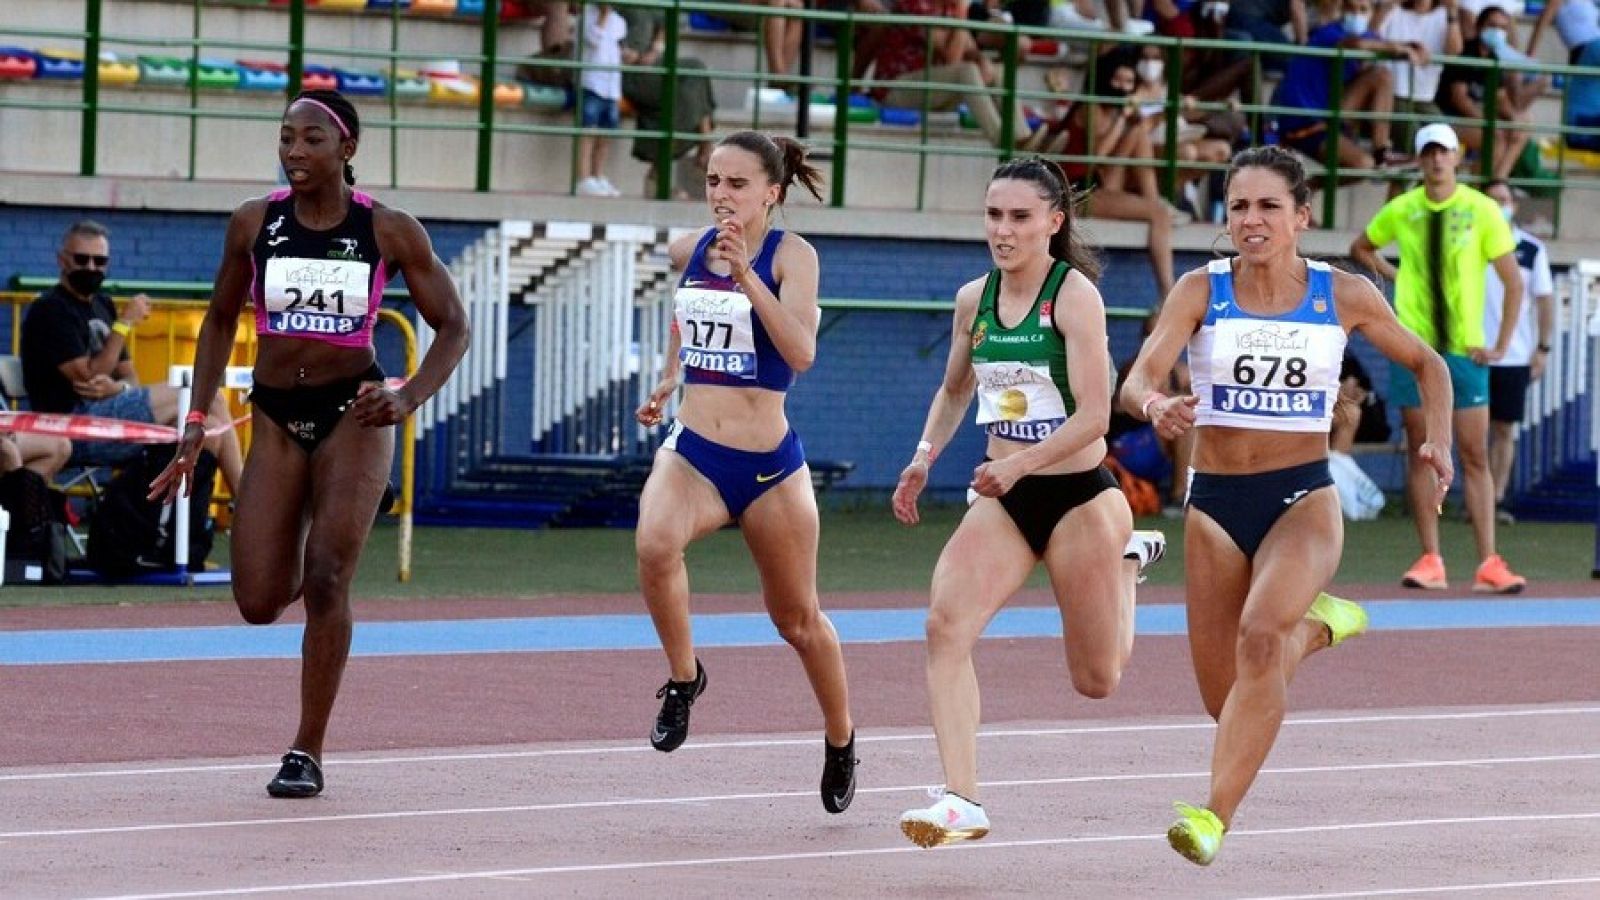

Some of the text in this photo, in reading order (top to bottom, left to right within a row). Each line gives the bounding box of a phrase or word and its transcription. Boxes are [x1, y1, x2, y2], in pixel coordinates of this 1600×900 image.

[284, 287, 345, 314] 241
[685, 319, 734, 350] 277
[1233, 353, 1308, 388] 678
